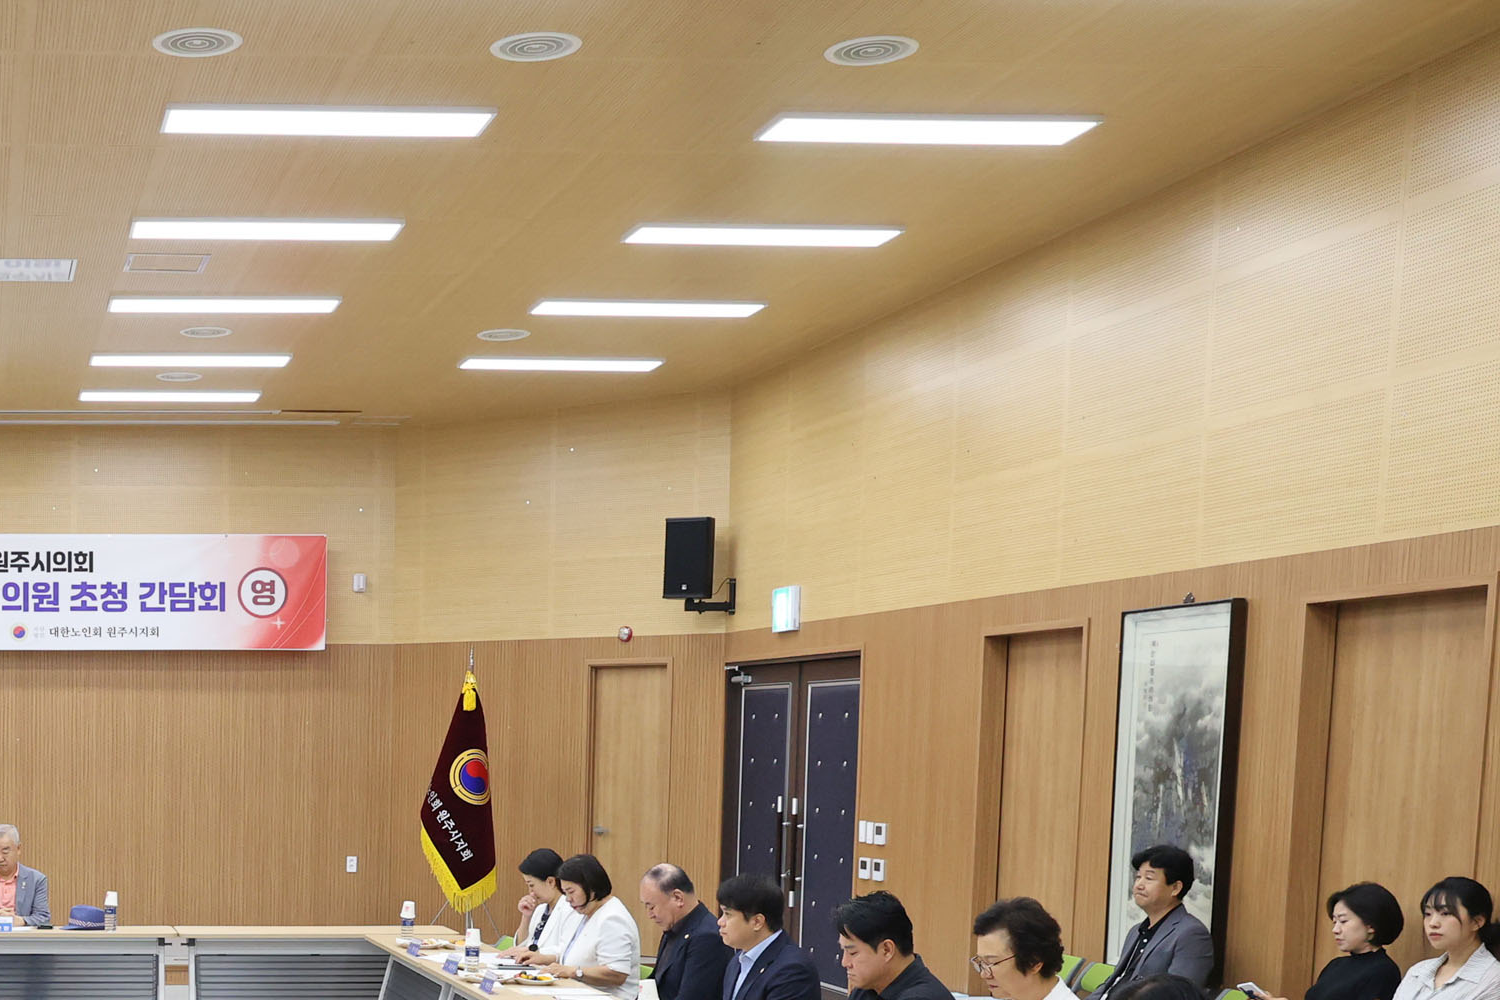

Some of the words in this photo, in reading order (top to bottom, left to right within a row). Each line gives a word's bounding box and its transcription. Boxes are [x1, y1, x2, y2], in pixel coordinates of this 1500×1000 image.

[1, 581, 60, 613] 의원
[69, 581, 128, 613] 초청
[138, 581, 226, 613] 간담회
[251, 579, 275, 606] 영
[49, 626, 102, 638] 대한노인회
[106, 626, 160, 638] 원주시지회
[436, 809, 474, 862] 원주시지회
